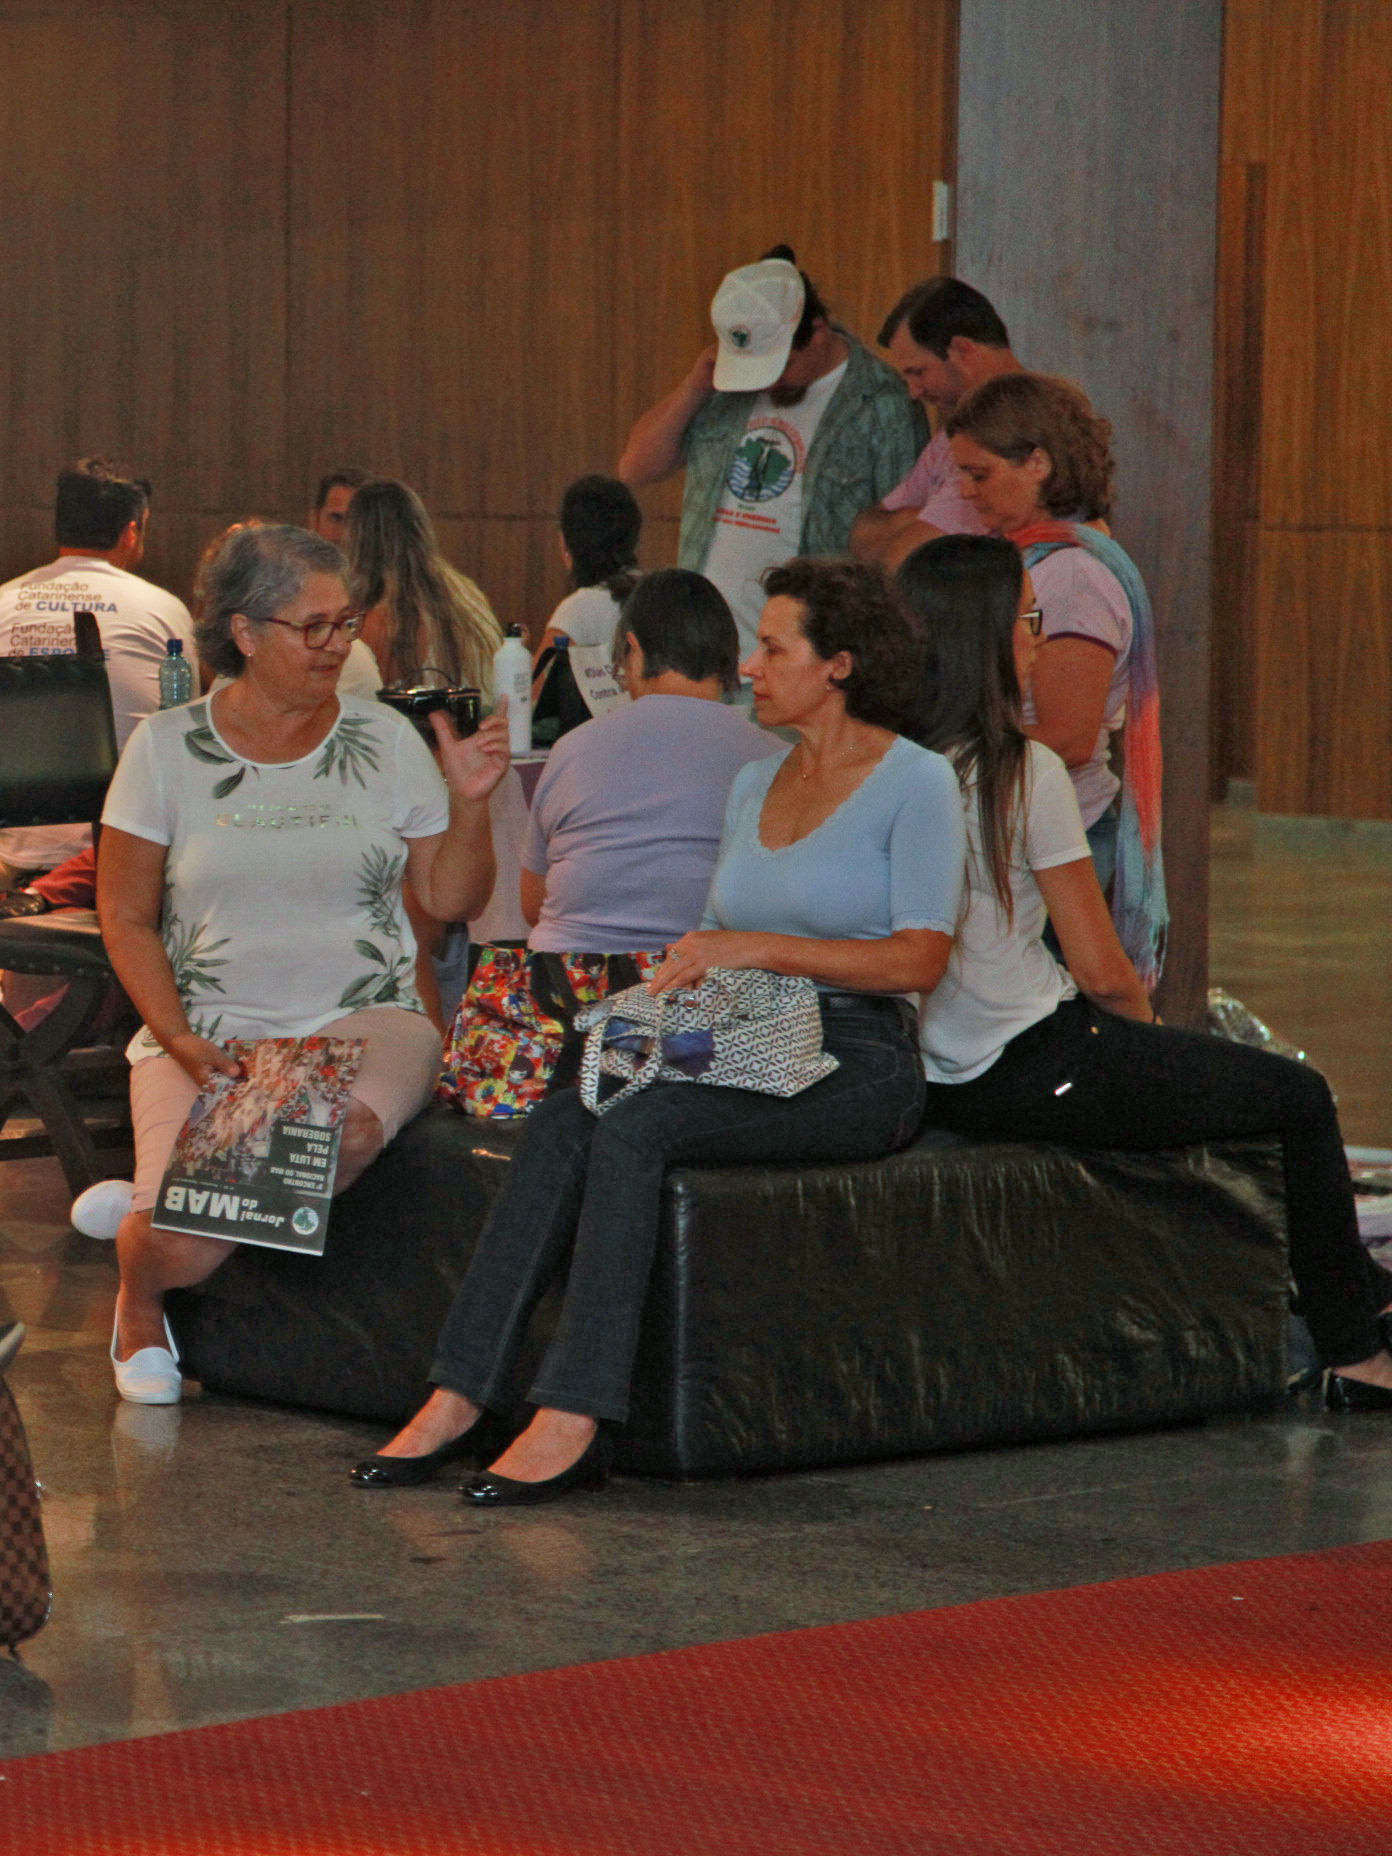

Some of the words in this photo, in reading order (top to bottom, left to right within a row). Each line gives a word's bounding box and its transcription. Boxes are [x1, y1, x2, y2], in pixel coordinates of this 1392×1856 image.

[20, 582, 89, 593] Fundação
[17, 590, 102, 602] Catarinense
[15, 602, 32, 611] de
[36, 601, 118, 613] CULTURA
[11, 622, 75, 637] Fundaçã
[10, 634, 77, 647] Catarinen
[282, 1125, 331, 1141] SOBERANIA
[307, 1142, 329, 1155] PELA
[289, 1153, 311, 1165] LUTA
[313, 1157, 327, 1168] EM
[164, 1186, 240, 1221] MAB
[242, 1199, 258, 1210] do
[240, 1211, 285, 1227] Jornal
